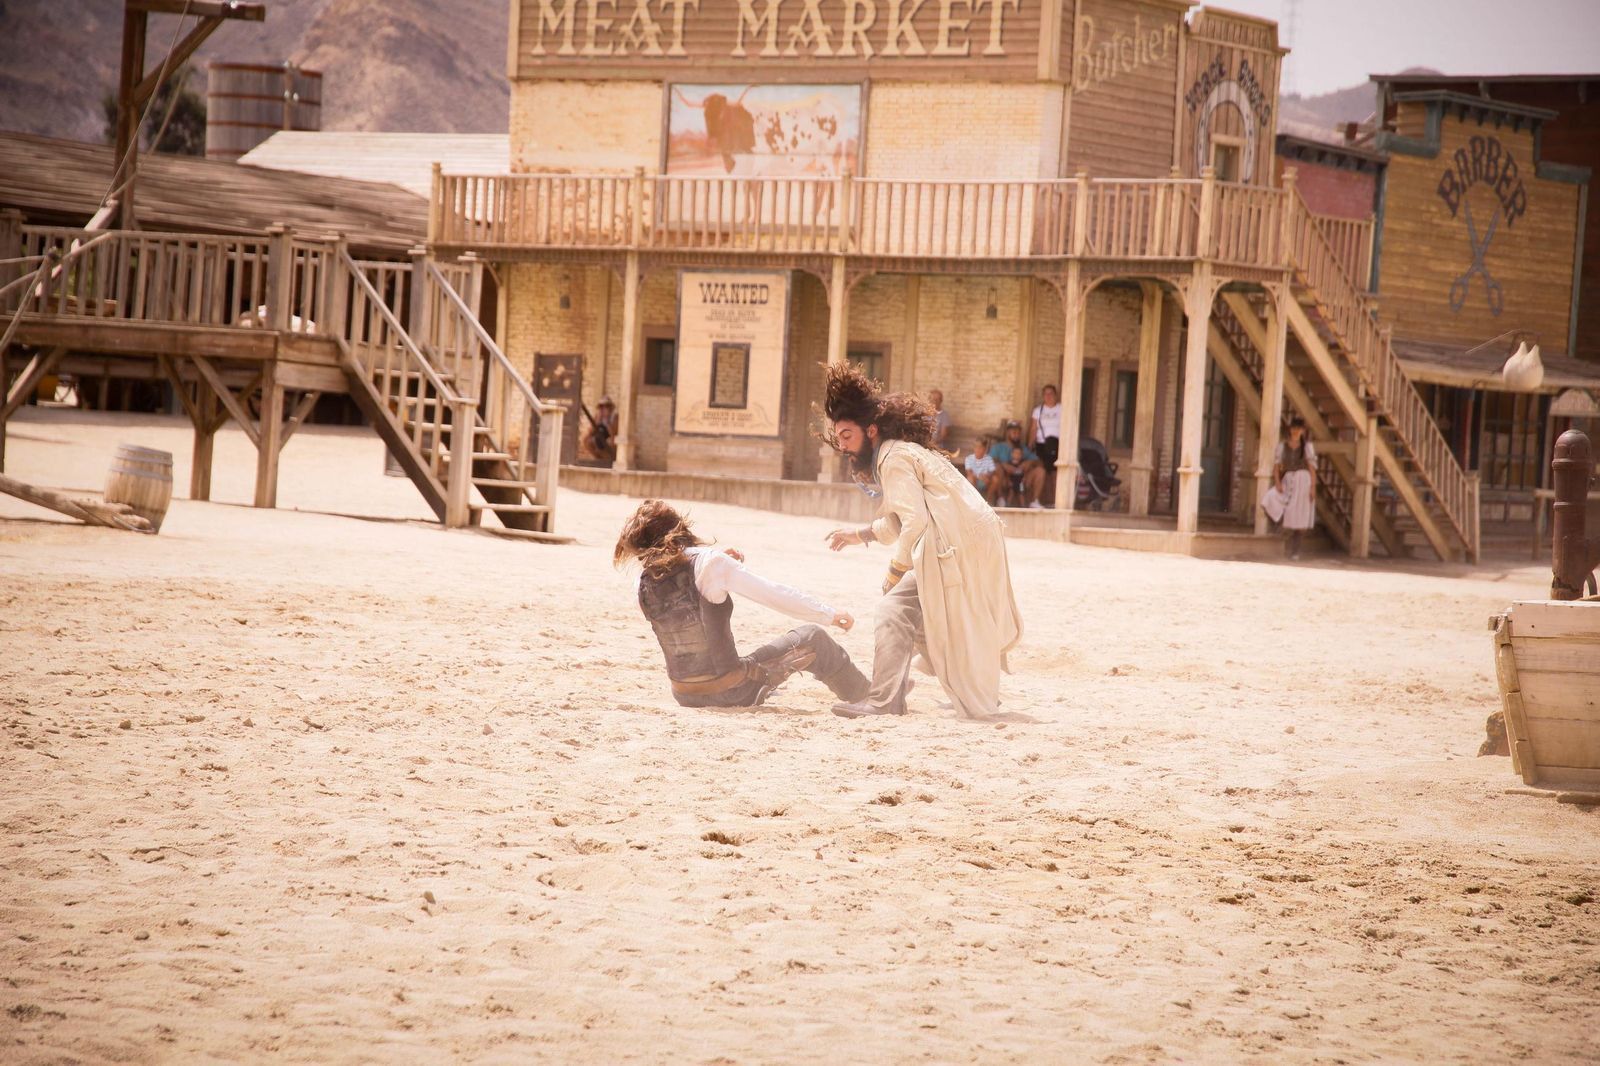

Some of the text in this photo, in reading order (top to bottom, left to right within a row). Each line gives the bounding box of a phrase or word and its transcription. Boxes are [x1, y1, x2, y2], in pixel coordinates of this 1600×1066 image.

[531, 0, 1019, 60] MEAT MARKET
[1074, 14, 1178, 94] Butcher
[1437, 135, 1526, 228] BARBER
[699, 282, 769, 304] WANTED
